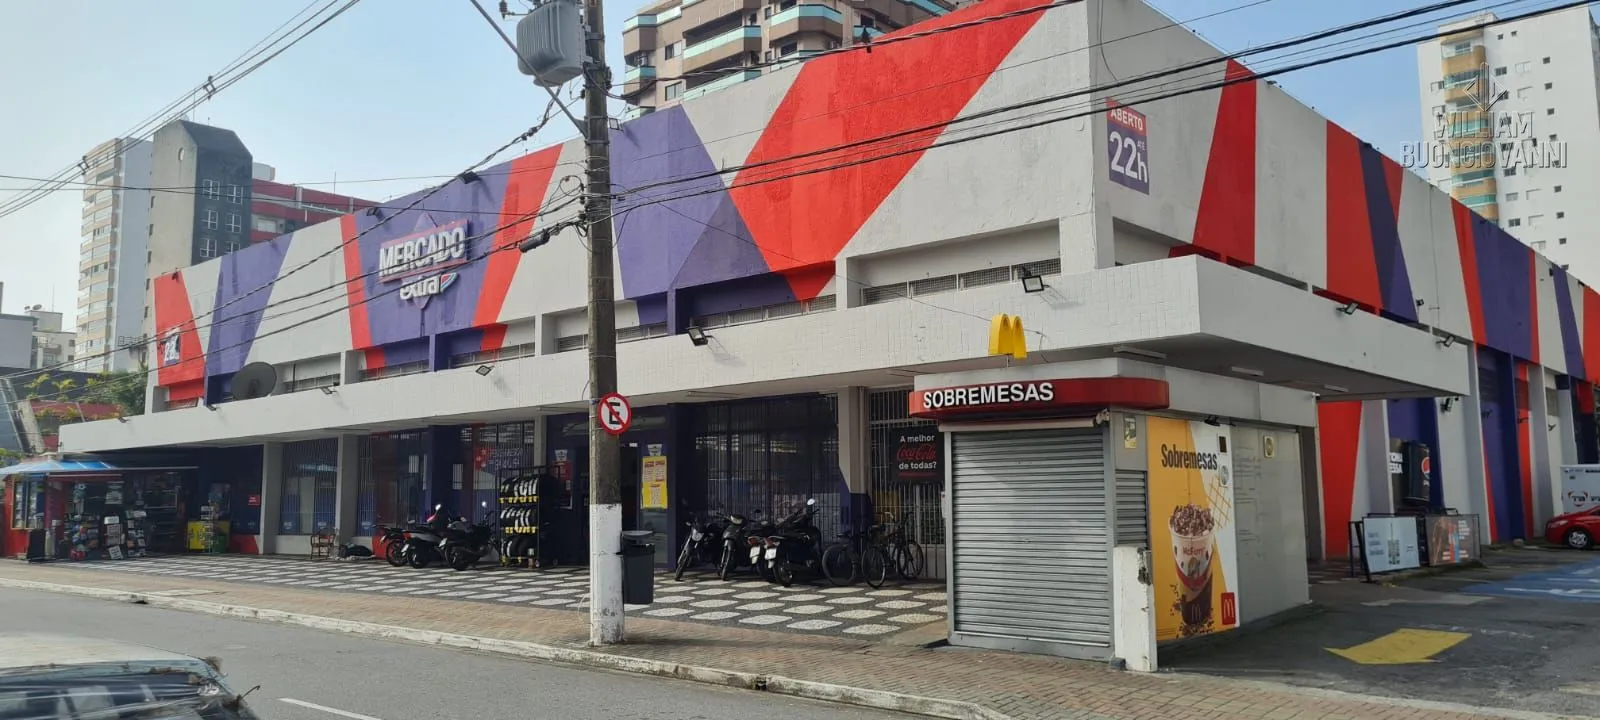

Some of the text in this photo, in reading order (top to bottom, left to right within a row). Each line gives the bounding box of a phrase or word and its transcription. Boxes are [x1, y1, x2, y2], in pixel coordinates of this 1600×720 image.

[1110, 108, 1143, 131] ABERTO
[1109, 131, 1148, 183] 22h
[379, 227, 466, 277] MERCADO
[399, 273, 440, 301] extra
[923, 382, 1054, 409] SOBREMESAS
[608, 401, 621, 425] E
[899, 434, 936, 443] A melhor
[899, 461, 937, 470] de todas?
[1160, 443, 1218, 471] Sobremesas
